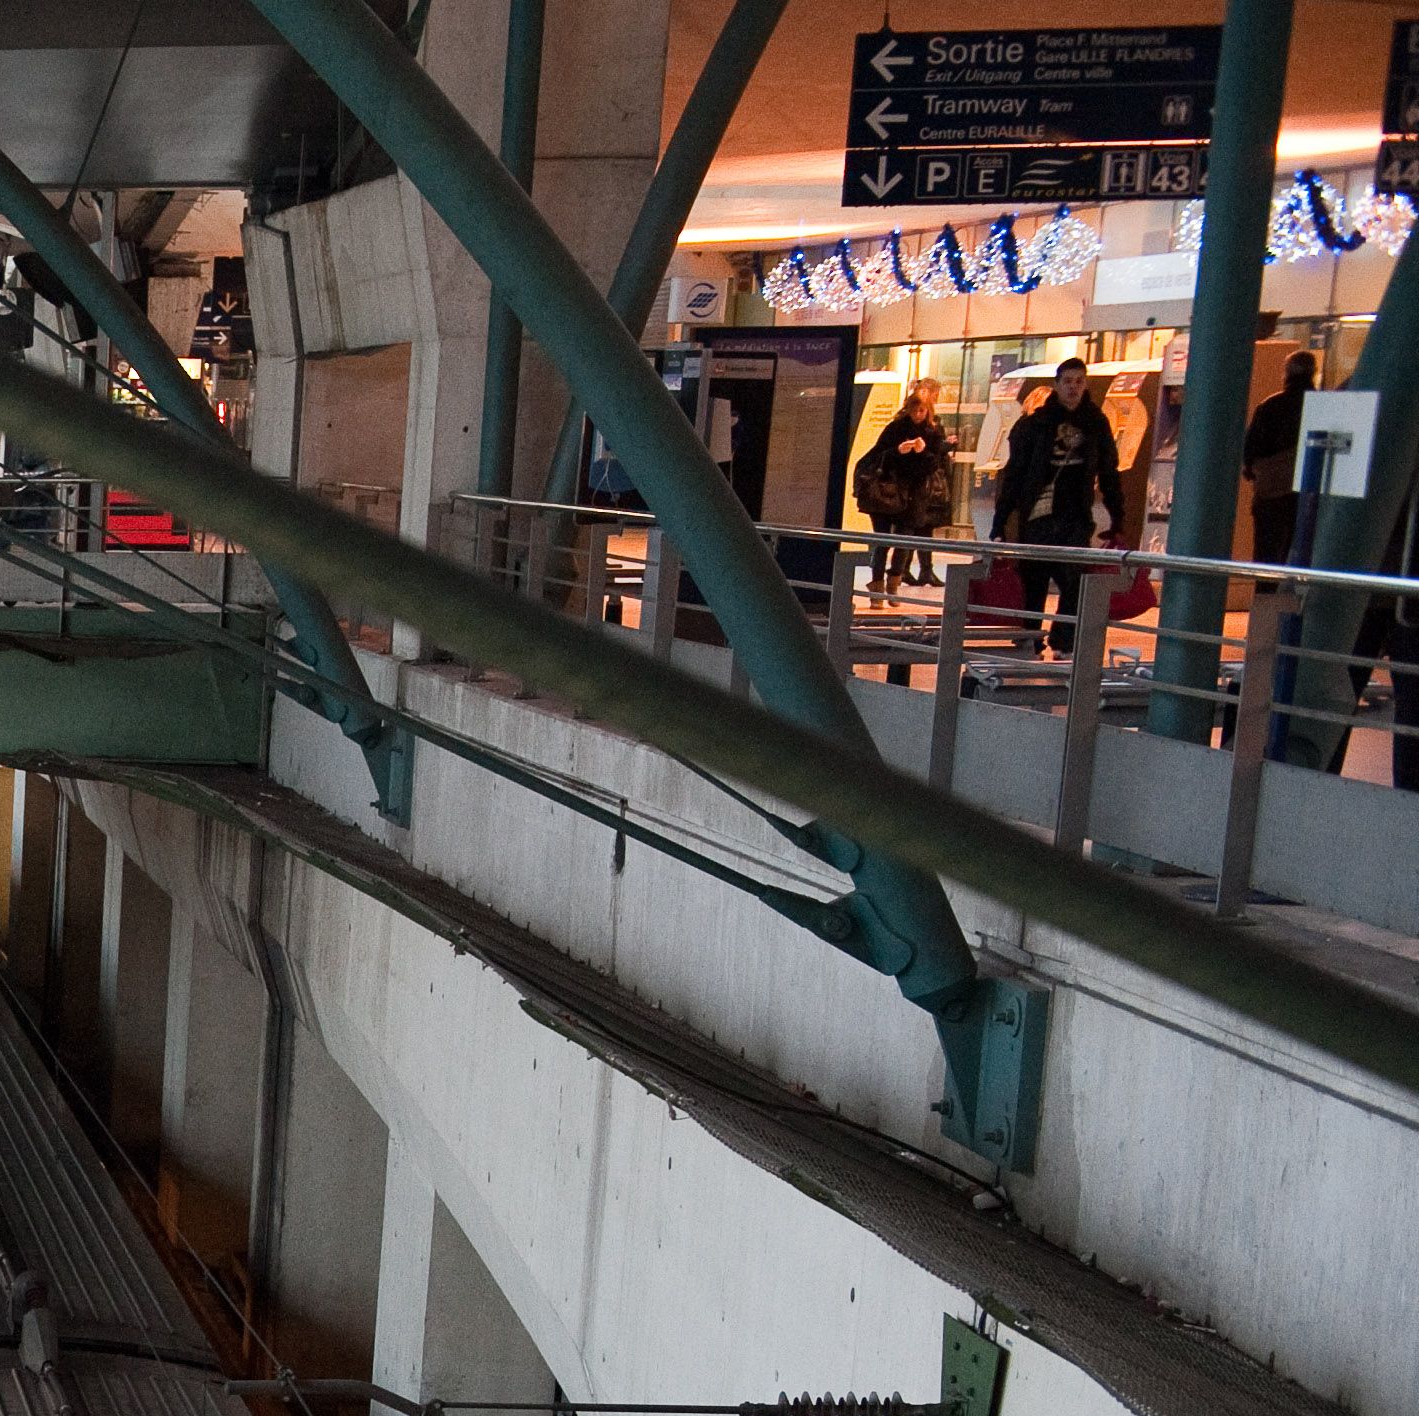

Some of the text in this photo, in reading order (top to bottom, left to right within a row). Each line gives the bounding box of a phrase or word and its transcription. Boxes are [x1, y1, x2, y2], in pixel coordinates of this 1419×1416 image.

[1036, 34, 1074, 47] Place
[926, 36, 1024, 65] Sortie
[1035, 47, 1196, 63] Gare LILLE FLANDRES
[924, 68, 953, 83] Exit
[964, 68, 1023, 84] Uitgang
[1033, 66, 1113, 80] Centre ville
[922, 94, 1074, 118] Tramway Tram
[918, 124, 1045, 140] Centre EURALILLE
[926, 161, 951, 193] P
[978, 169, 996, 193] E
[1151, 164, 1191, 192] 43
[1010, 186, 1097, 198] eurostar
